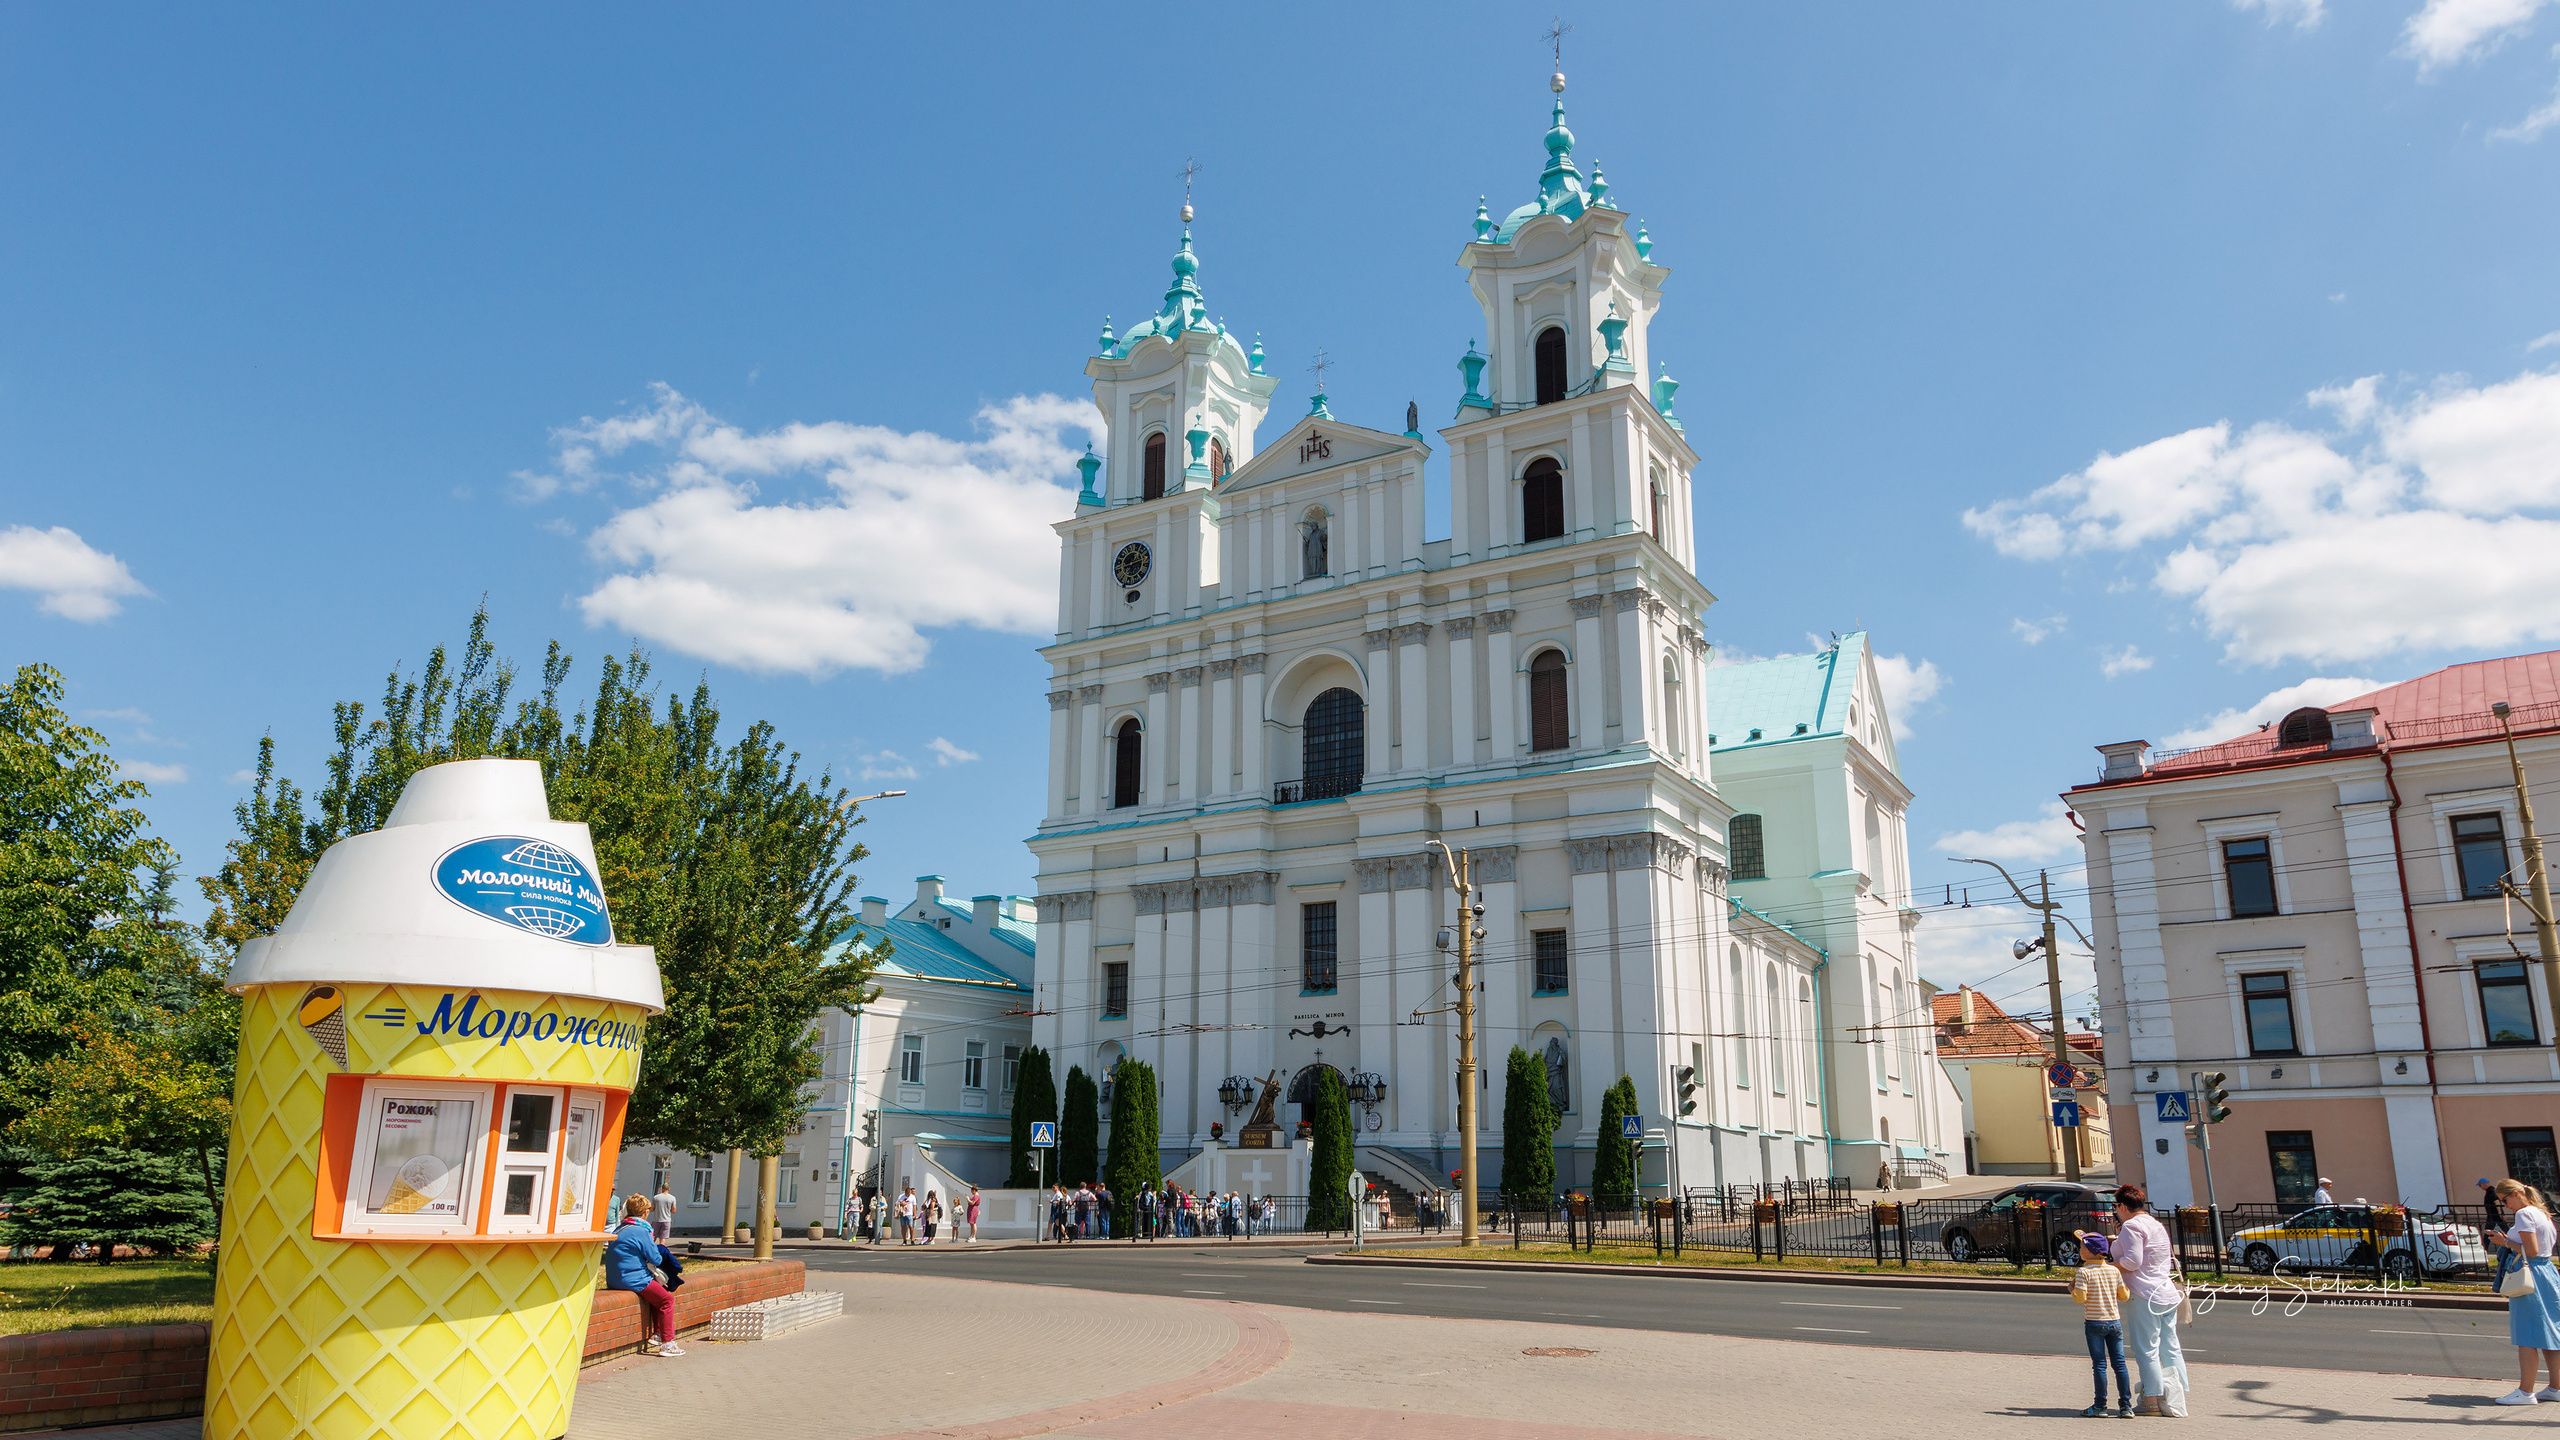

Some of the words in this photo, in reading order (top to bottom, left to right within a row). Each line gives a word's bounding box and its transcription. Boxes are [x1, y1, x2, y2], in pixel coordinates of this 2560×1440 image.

[1299, 437, 1331, 464] IHS
[457, 869, 574, 897] Молочный
[576, 885, 603, 913] Мир
[521, 891, 542, 901] сила
[543, 894, 572, 907] молока
[416, 993, 643, 1053] Мороженое
[387, 1101, 435, 1116] Рожок
